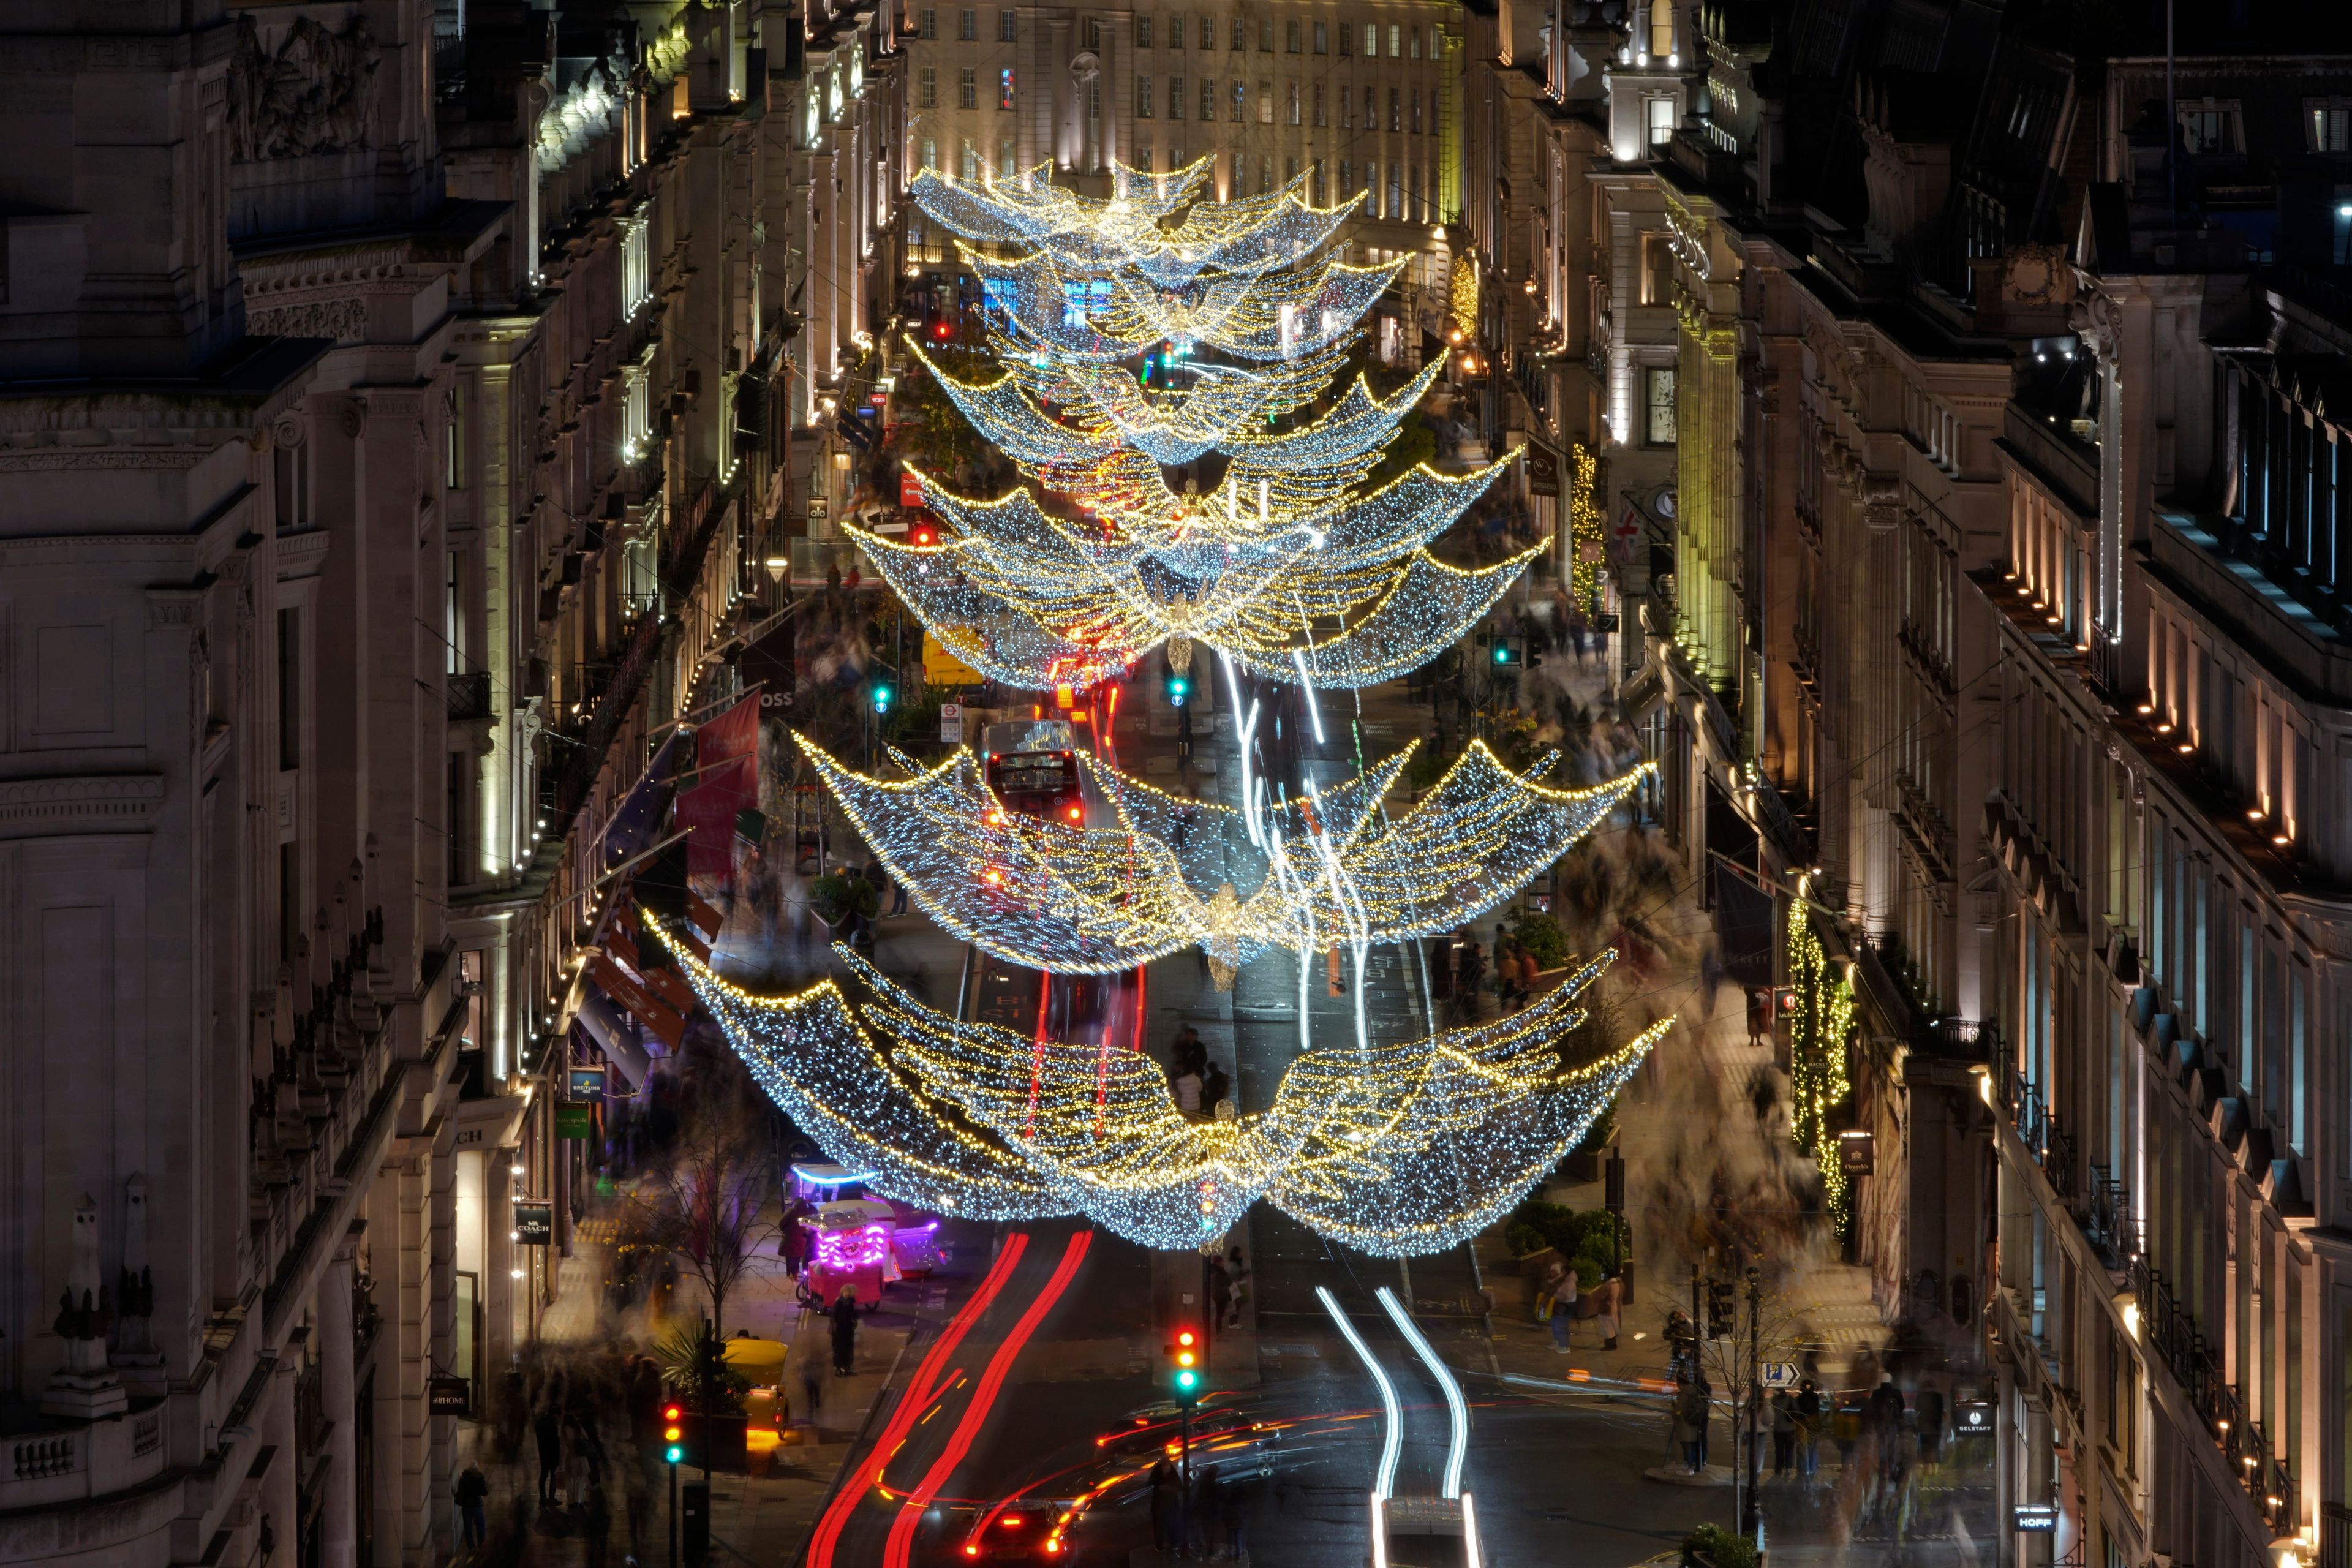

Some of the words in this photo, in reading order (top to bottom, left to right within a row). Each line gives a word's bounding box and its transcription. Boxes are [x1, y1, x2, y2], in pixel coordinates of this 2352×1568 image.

[810, 506, 826, 517] alo
[760, 691, 794, 708] OSS
[2019, 1518, 2051, 1527] HOFF
